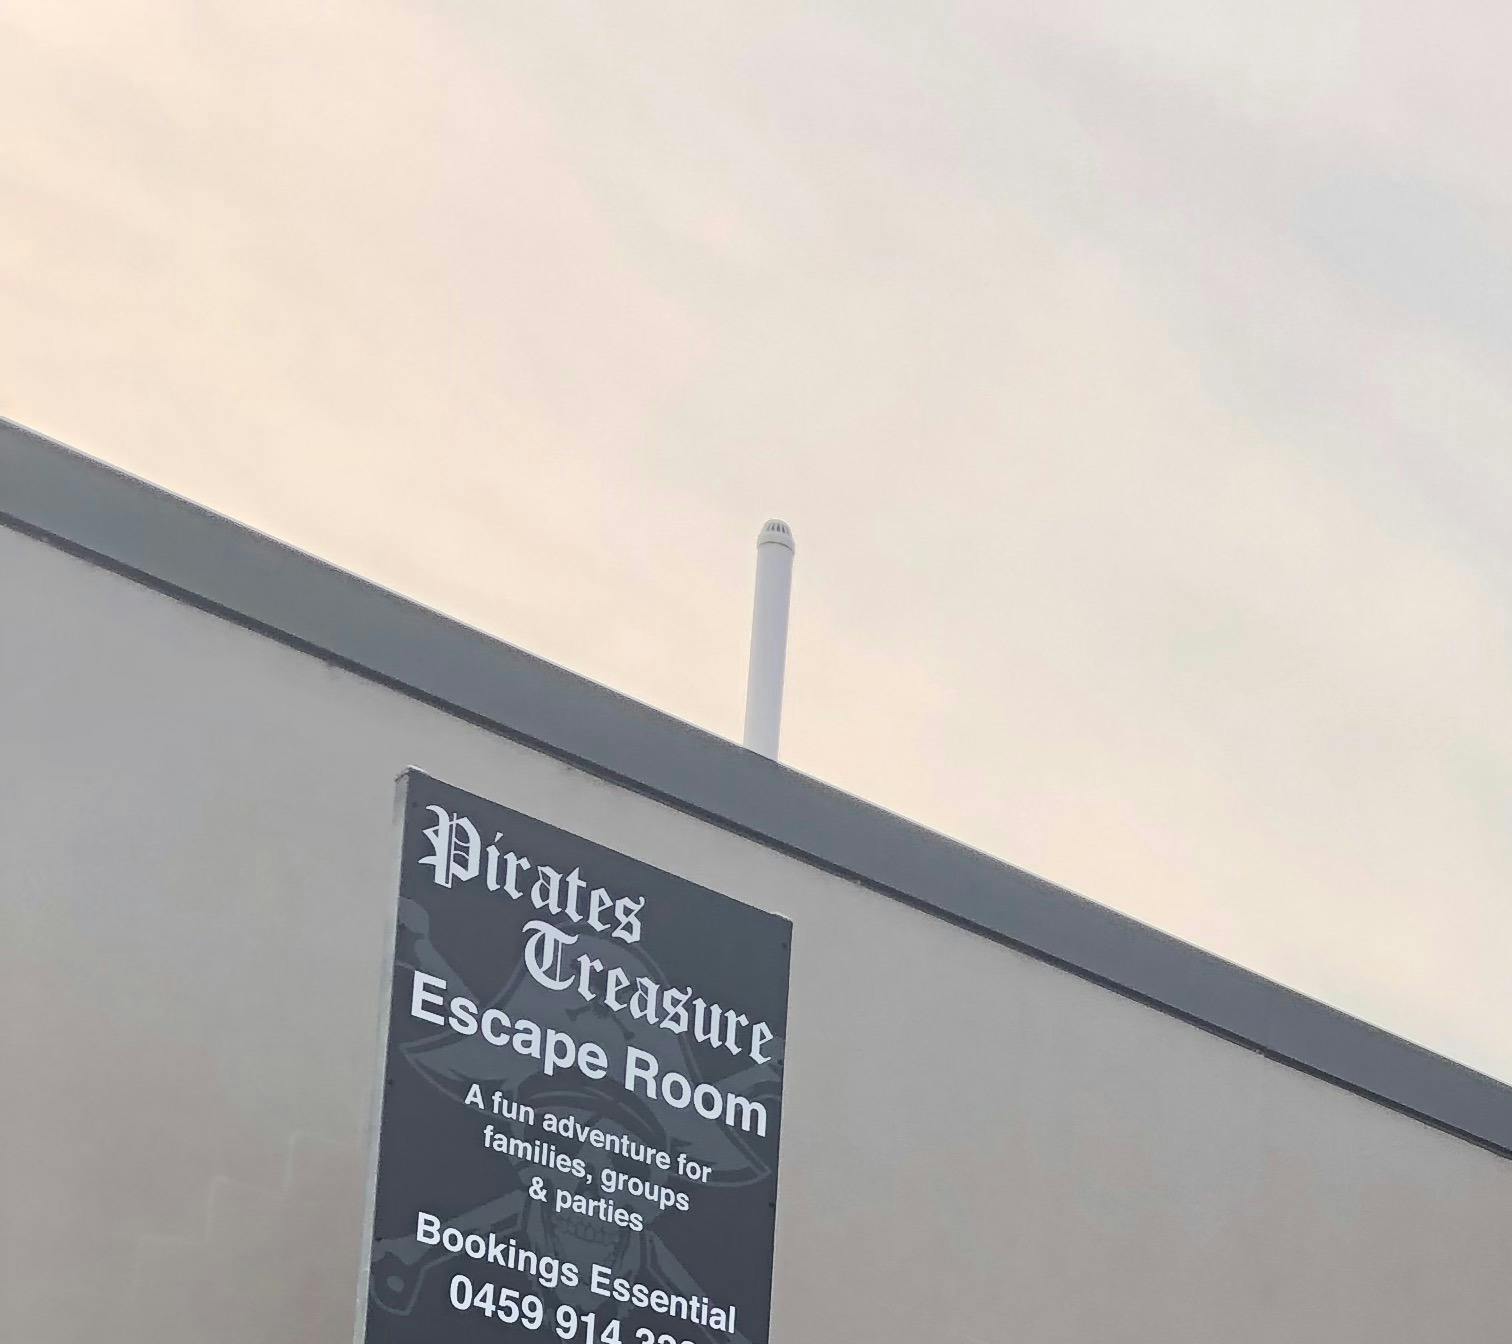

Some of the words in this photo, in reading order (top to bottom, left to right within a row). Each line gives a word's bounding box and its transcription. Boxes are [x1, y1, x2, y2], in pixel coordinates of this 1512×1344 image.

[418, 805, 645, 943] Pirates
[521, 920, 775, 1065] Treasure
[411, 970, 608, 1080] Escape
[624, 1046, 767, 1137] Room
[464, 1084, 485, 1109] A
[492, 1091, 535, 1125] fun
[543, 1107, 671, 1171] adventure
[678, 1155, 711, 1183] for
[483, 1126, 593, 1185] families,
[601, 1167, 689, 1211] groups
[528, 1177, 548, 1201] &
[556, 1186, 644, 1231] parties
[416, 1212, 578, 1289] Bookings
[589, 1264, 736, 1333] Essential
[450, 1274, 544, 1330] 0459
